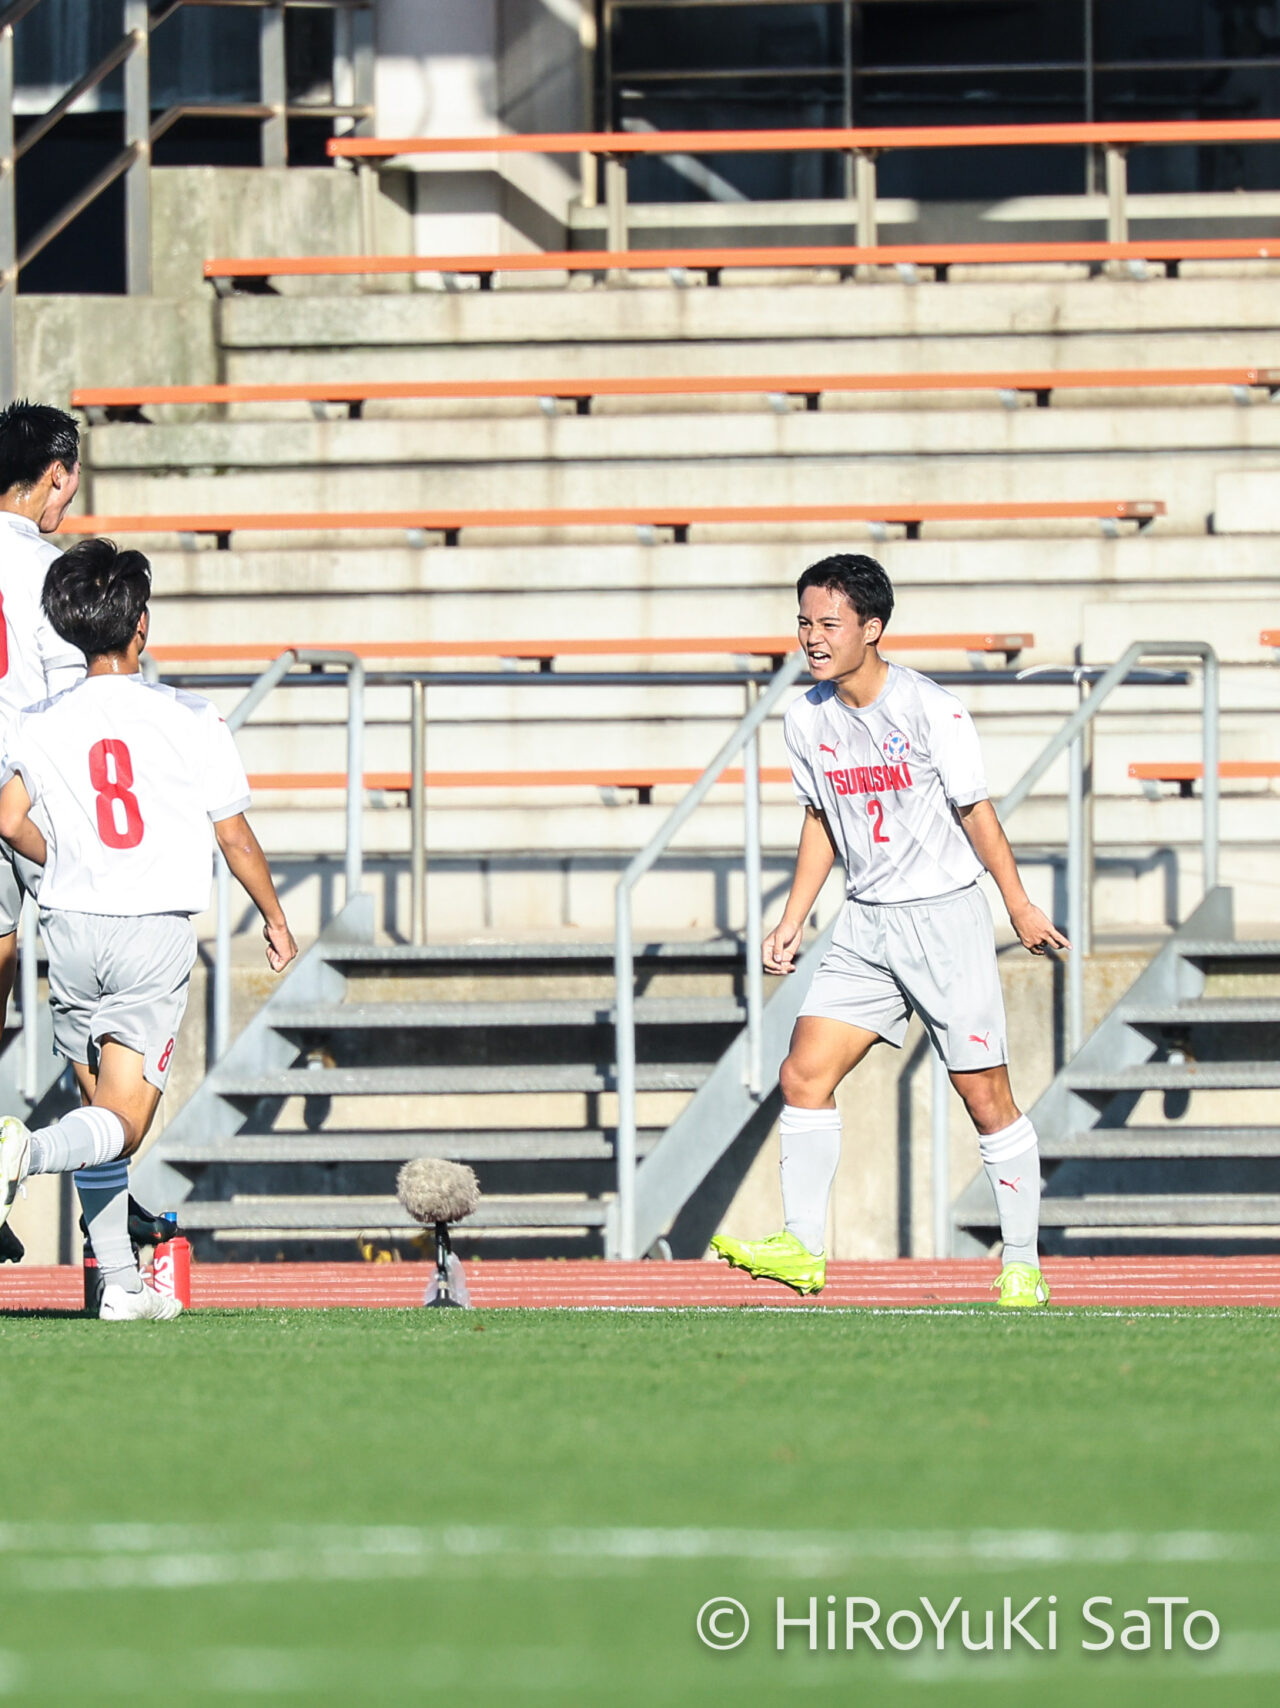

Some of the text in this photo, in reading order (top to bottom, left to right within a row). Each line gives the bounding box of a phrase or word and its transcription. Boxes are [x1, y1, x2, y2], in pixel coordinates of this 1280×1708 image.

[88, 738, 144, 849] 8
[866, 799, 890, 843] 2
[157, 1037, 174, 1072] 8
